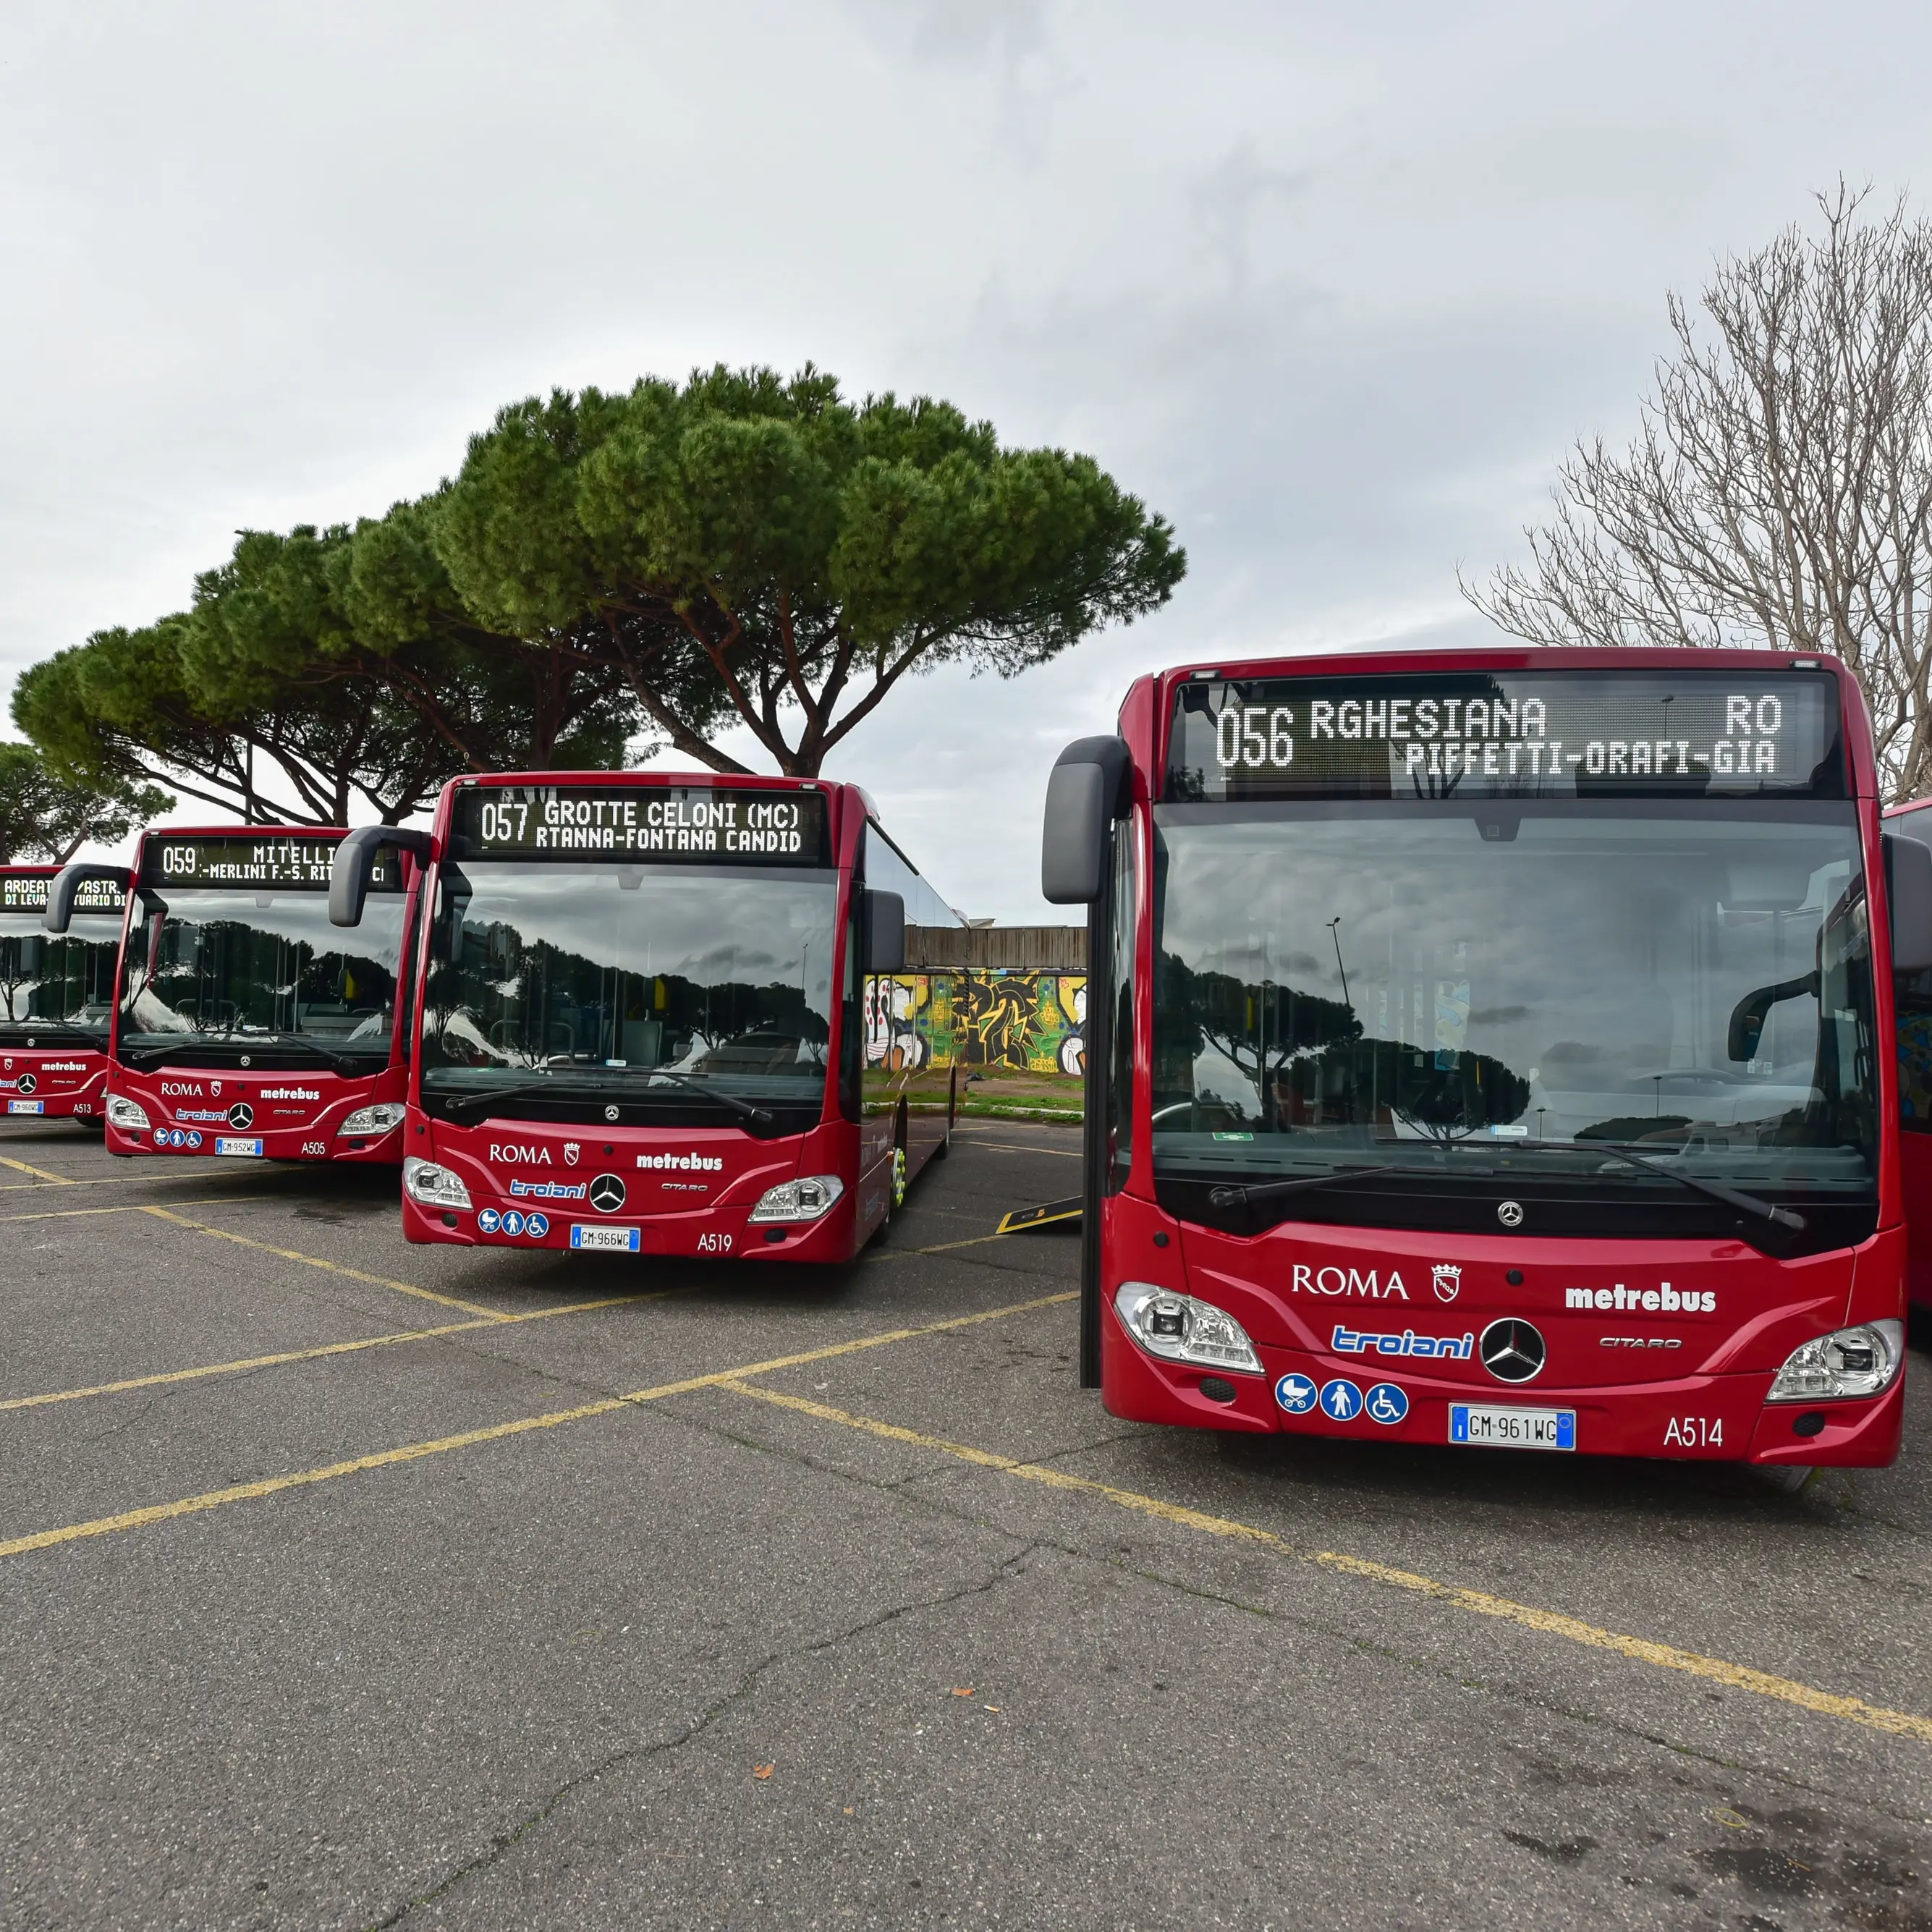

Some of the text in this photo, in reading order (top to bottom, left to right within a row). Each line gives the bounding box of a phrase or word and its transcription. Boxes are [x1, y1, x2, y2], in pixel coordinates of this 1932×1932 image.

[1310, 695, 1781, 738] RGHESIANA RO
[1216, 708, 1294, 767] 056
[1406, 741, 1775, 775] PIFFETTI-ORAFI-GIA
[481, 803, 528, 841] 057
[544, 800, 799, 829] GROTTE CELONI (MC)
[536, 827, 801, 852] RTANNA-FONTANA CANDID
[163, 847, 195, 873] 059
[253, 846, 336, 865] MITELLI
[199, 863, 266, 878] -MERLINI
[310, 865, 333, 881] RIT
[4, 880, 53, 894] ARDEAT
[5, 894, 17, 905] DI
[114, 894, 126, 906] DI
[41, 1062, 87, 1071] metrebus
[161, 1082, 203, 1096] ROMA
[260, 1088, 320, 1101] metrebus
[73, 1103, 92, 1114] A513
[176, 1109, 228, 1122] troiani
[301, 1142, 326, 1155] A505
[489, 1144, 552, 1165] ROMA
[637, 1152, 723, 1172] metrebus
[509, 1179, 588, 1200] troiani
[661, 1183, 708, 1192] CITARO
[697, 1233, 733, 1253] A519
[1292, 1265, 1410, 1300] ROMA
[1564, 1282, 1717, 1313] metrebus
[1331, 1325, 1475, 1360] troiani
[1599, 1336, 1682, 1349] CITARO
[1664, 1417, 1723, 1447] A514
